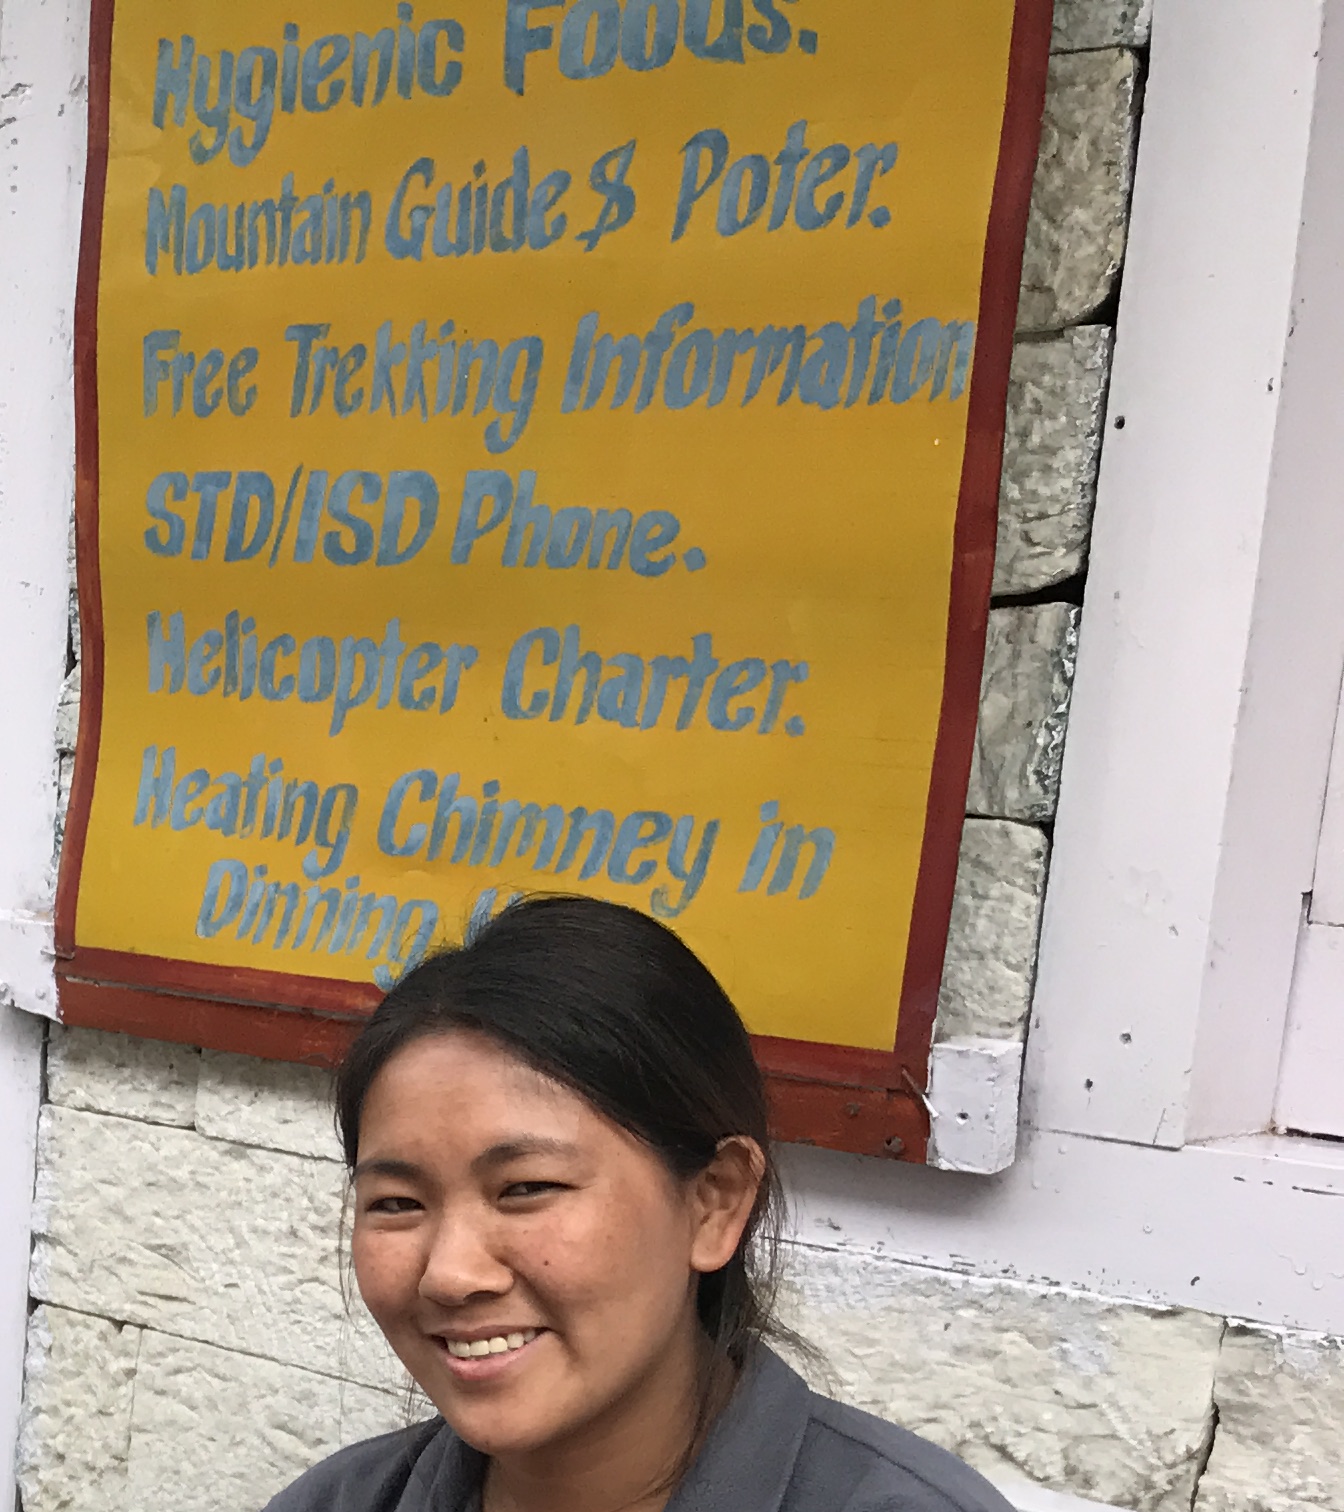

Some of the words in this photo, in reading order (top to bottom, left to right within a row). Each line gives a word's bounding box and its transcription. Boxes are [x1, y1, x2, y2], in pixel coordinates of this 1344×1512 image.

[151, 2, 465, 165] Hygienic
[144, 172, 372, 275] Mountain
[671, 120, 898, 245] Poter.
[143, 329, 259, 420] Free
[284, 320, 544, 453] Trekking
[560, 295, 976, 415] Information
[143, 464, 440, 569] STD/ISD
[450, 470, 706, 577] Phone.
[145, 609, 479, 736] Helicopter
[503, 623, 810, 736] Charter.
[133, 745, 358, 878] Heating
[376, 768, 720, 919] Chimney
[738, 799, 836, 900] in
[196, 859, 440, 991] Dinning
